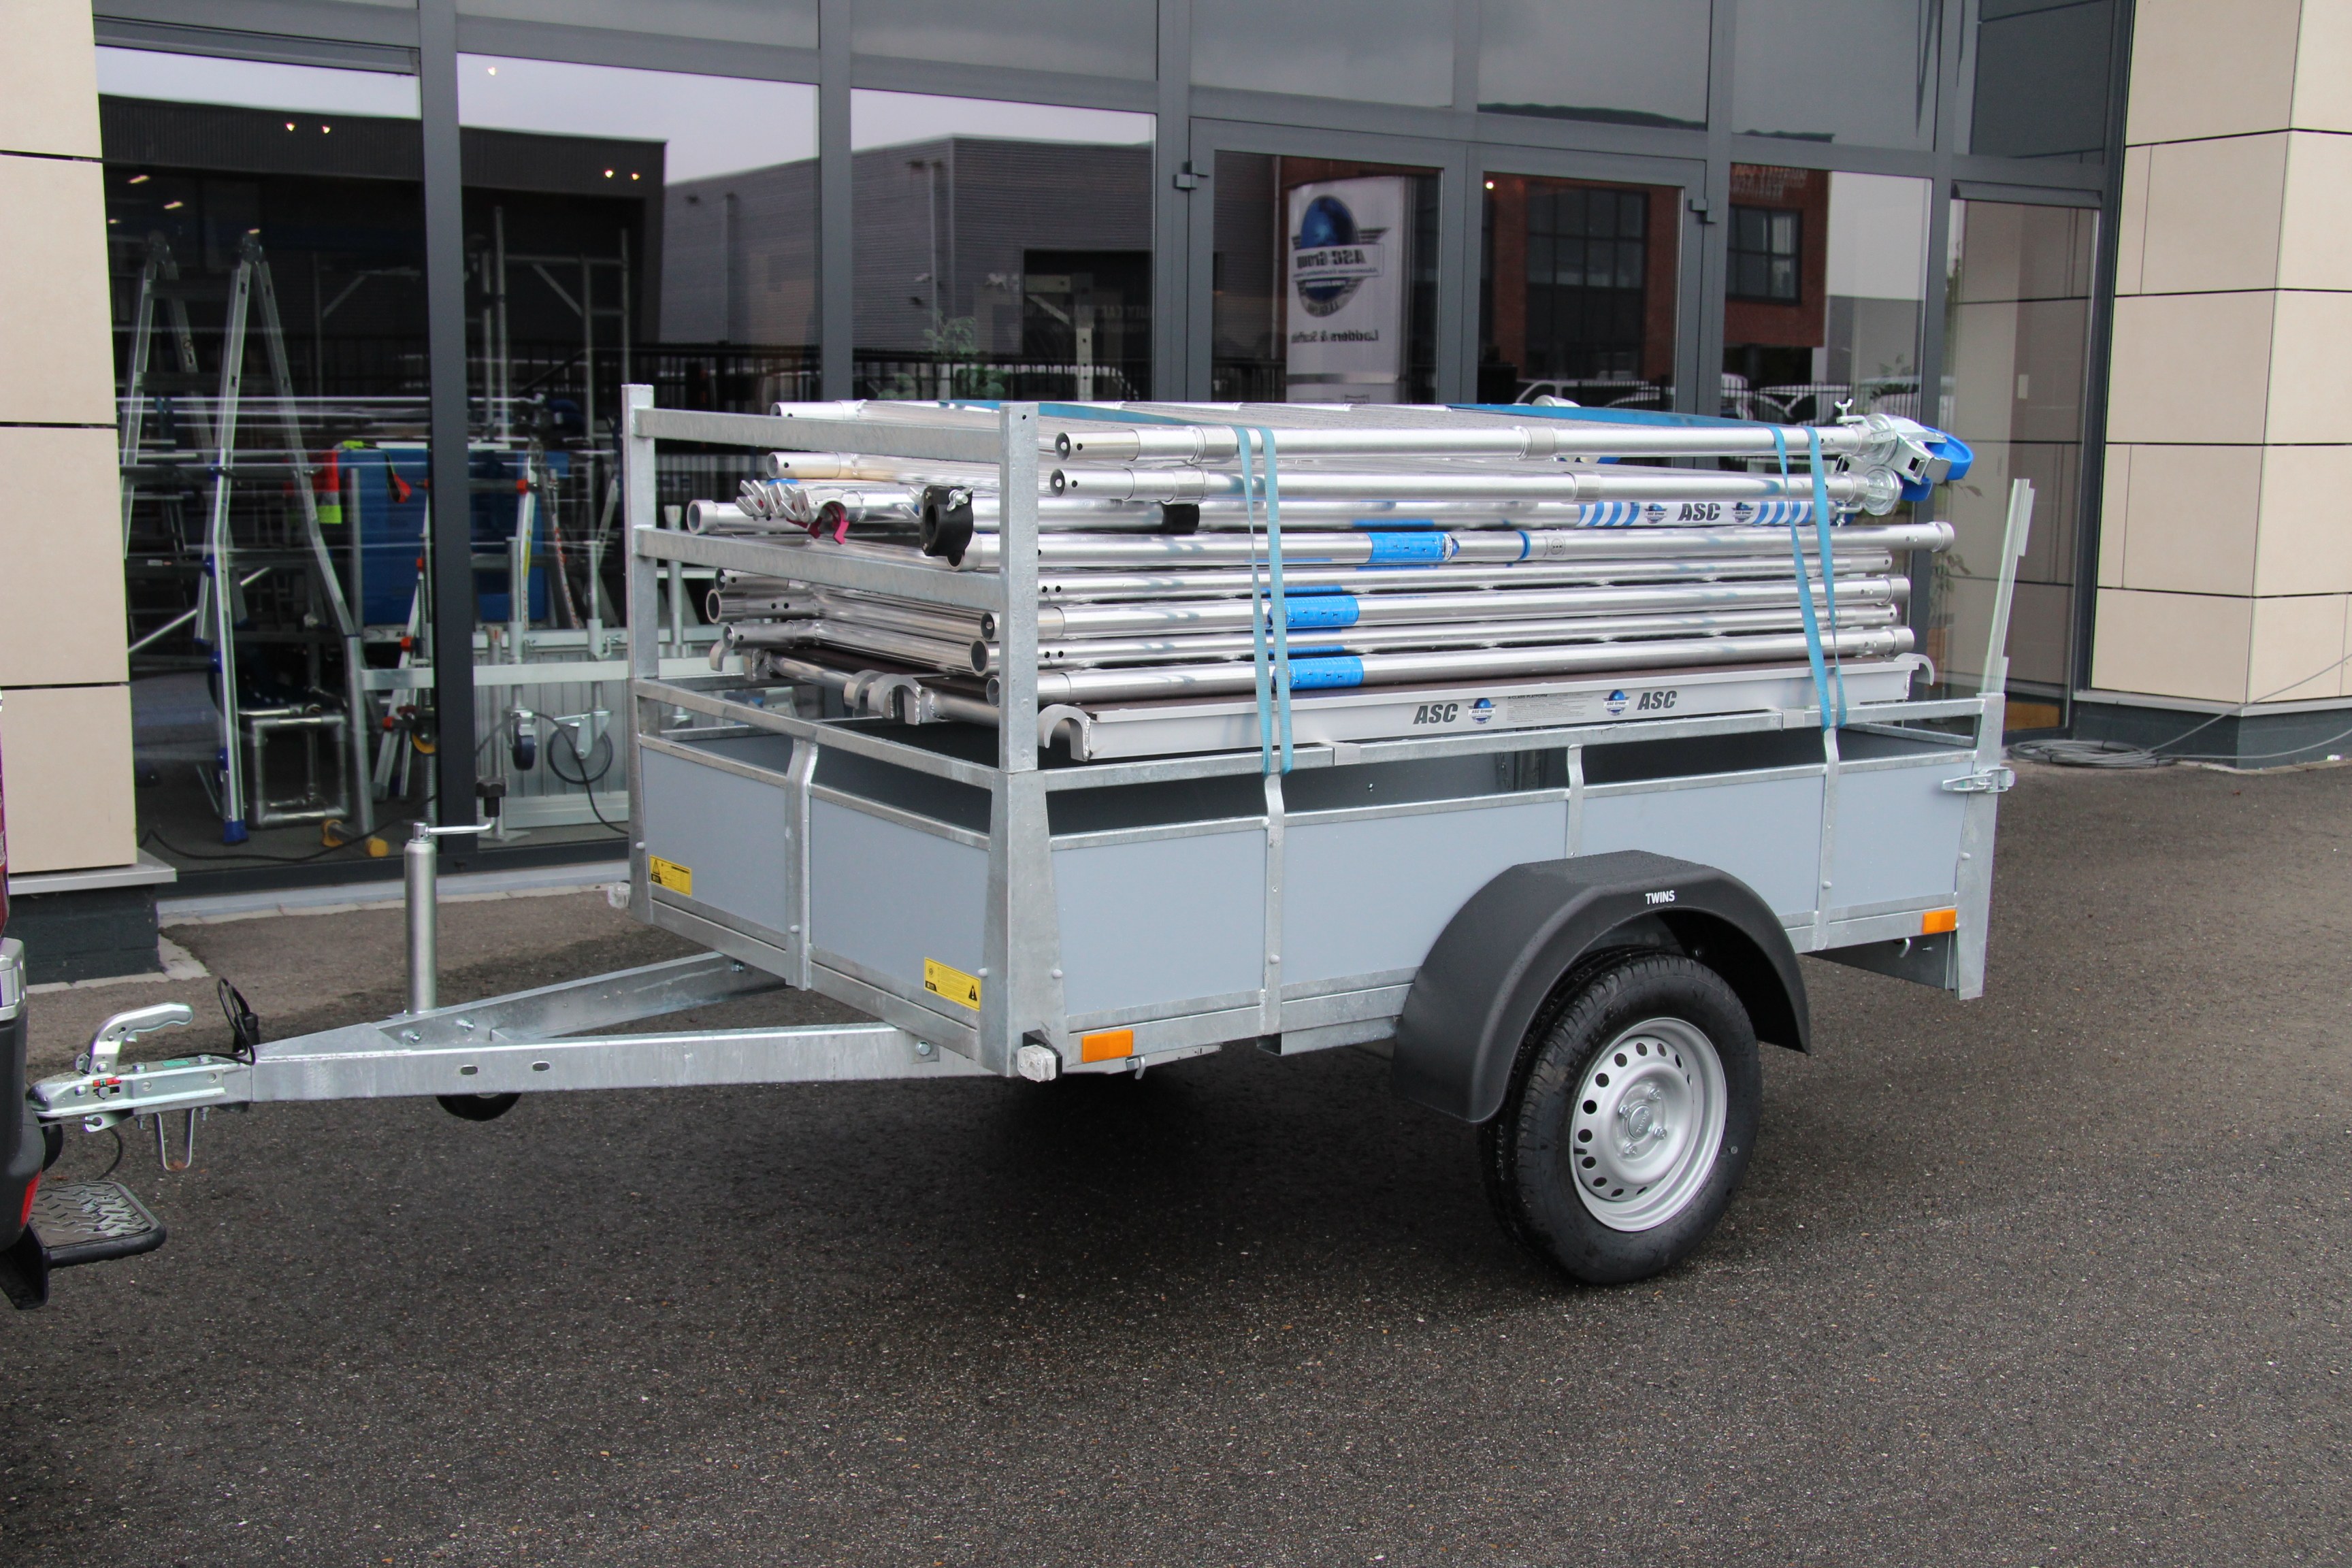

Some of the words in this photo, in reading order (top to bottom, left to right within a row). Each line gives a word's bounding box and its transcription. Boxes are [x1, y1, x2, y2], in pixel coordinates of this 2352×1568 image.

[1678, 502, 1720, 521] ASC
[1636, 690, 1677, 710] ASC
[1412, 703, 1458, 725] ASC
[1645, 889, 1676, 905] TWINS
